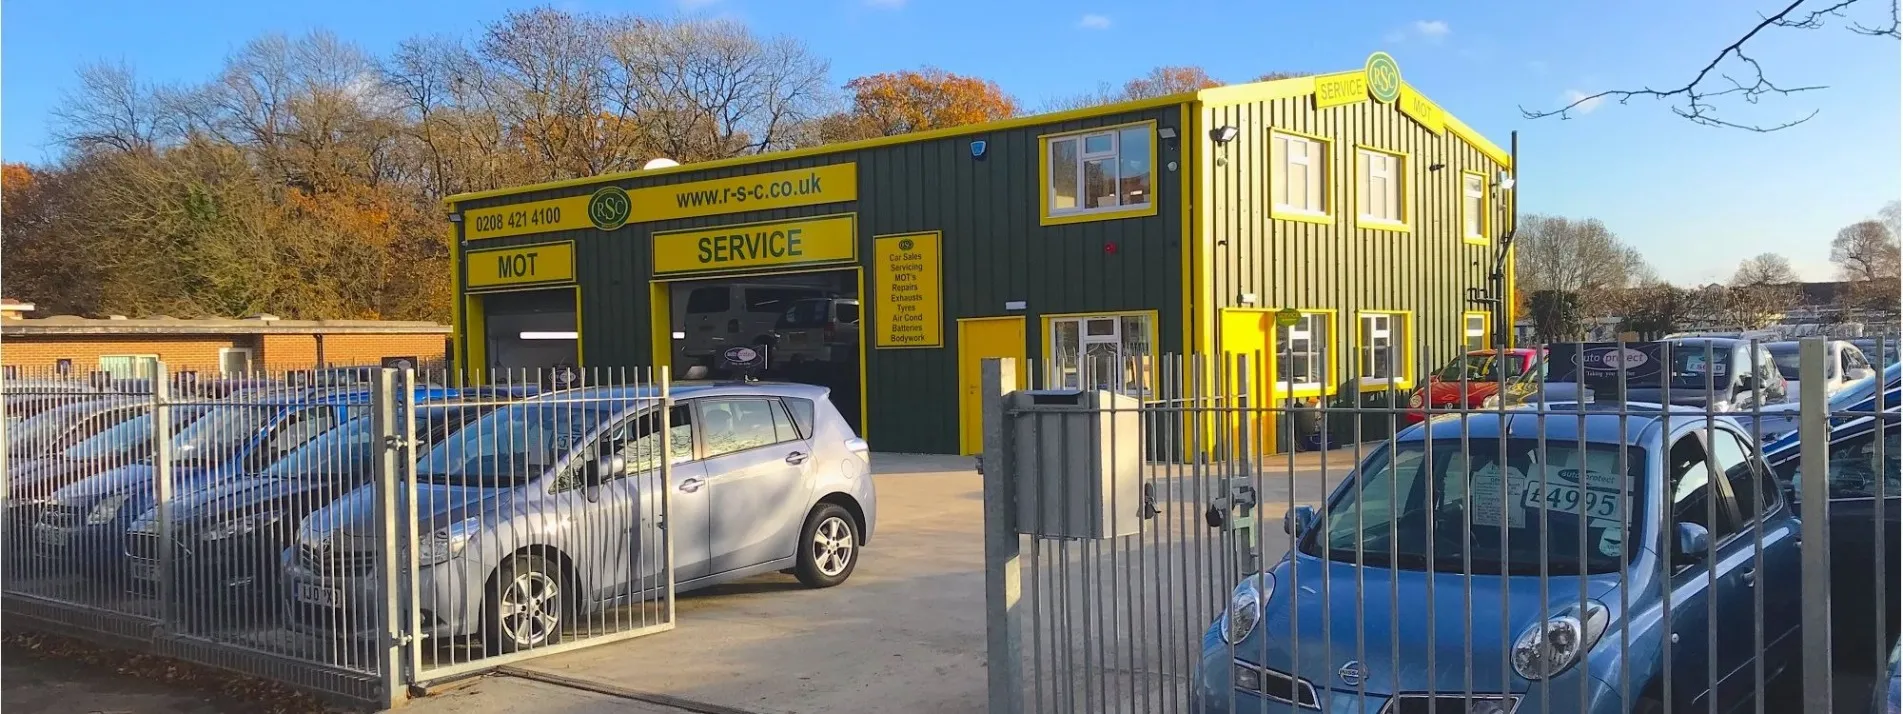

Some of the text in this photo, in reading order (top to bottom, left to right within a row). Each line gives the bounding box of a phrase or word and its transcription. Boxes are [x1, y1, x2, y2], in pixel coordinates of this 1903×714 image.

[1373, 65, 1395, 92] RSC
[1320, 79, 1363, 100] SERVICE
[1413, 97, 1432, 122] MOT
[676, 173, 822, 209] www.r-s-c.co.uk
[597, 197, 624, 220] RSC
[476, 207, 561, 232] 0208 421 4100
[698, 229, 803, 264] SERVICE
[889, 252, 922, 262] Car Sales
[498, 253, 538, 279] MOT
[890, 263, 923, 272] Servicing
[894, 273, 917, 281] MOT's
[892, 283, 918, 292] Repairs
[891, 294, 923, 302] Exhausts
[897, 303, 916, 313] Tyres
[892, 313, 923, 322] Air Cond
[891, 324, 923, 332] Batteries
[890, 334, 925, 343] Bodywork
[1576, 353, 1601, 362] uto
[1529, 486, 1616, 517] £4995
